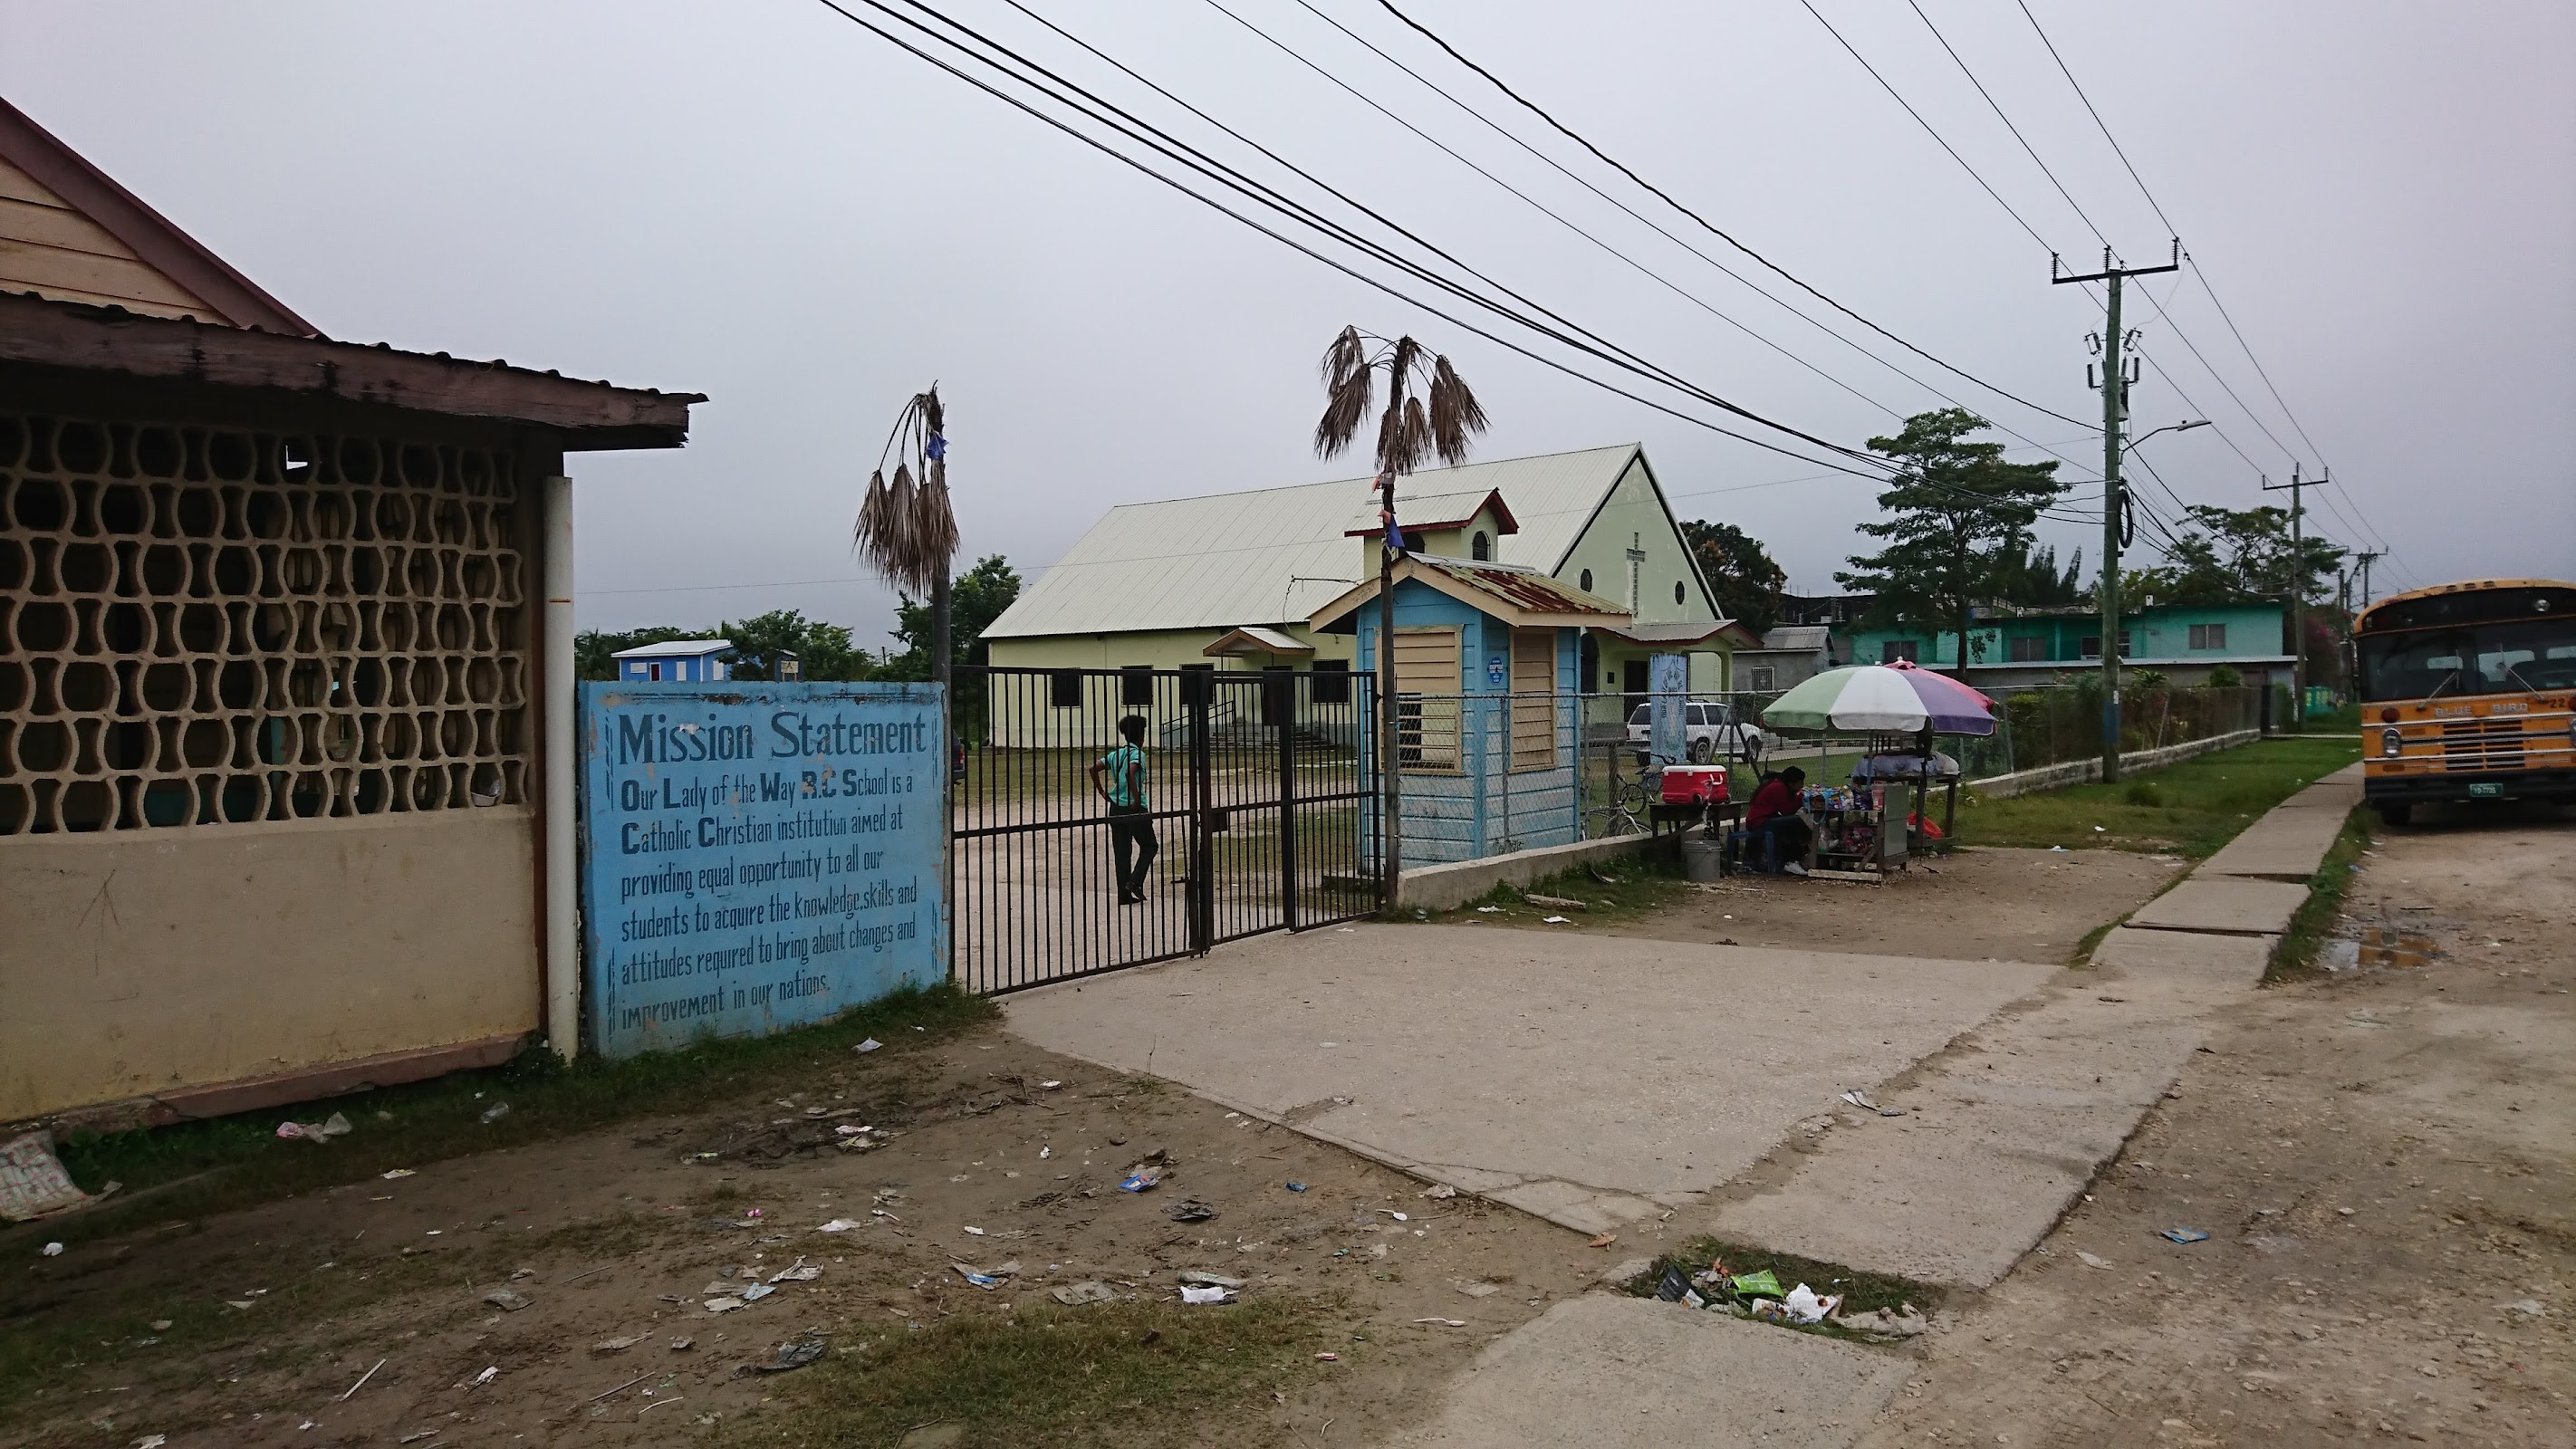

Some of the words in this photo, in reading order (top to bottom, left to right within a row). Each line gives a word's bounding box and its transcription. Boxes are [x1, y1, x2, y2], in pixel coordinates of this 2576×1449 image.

[2435, 705, 2472, 716] BLUE
[2493, 703, 2529, 714] BIRD
[2550, 697, 2565, 708] 22
[619, 713, 754, 765] Mission
[771, 711, 927, 758] Statement
[621, 779, 658, 811] Our
[663, 776, 707, 814] Lady
[712, 774, 729, 806] of
[734, 773, 756, 804] the
[760, 772, 796, 808] Way
[842, 767, 888, 796] School
[892, 776, 902, 793] is
[907, 775, 913, 792] a
[621, 819, 692, 854] Catholic
[697, 814, 772, 848] Christian
[777, 809, 847, 840] institution
[890, 803, 903, 830] at
[621, 861, 695, 905] providing
[698, 855, 734, 894] equal
[740, 849, 822, 888] opportunity
[827, 847, 841, 875] to
[846, 843, 859, 872] all
[863, 850, 883, 870] our
[621, 905, 689, 942] students
[695, 902, 709, 933] to
[715, 905, 764, 930] acquire
[770, 892, 791, 922] the
[898, 875, 917, 904] and
[622, 946, 692, 985] attitudes
[697, 936, 754, 978] required
[758, 935, 772, 964] to
[776, 931, 809, 965] bring
[812, 923, 845, 955] about
[850, 920, 893, 953] changes
[898, 911, 915, 940] and
[622, 985, 725, 1031] improvement
[733, 980, 745, 1010] in
[751, 984, 774, 1005] our
